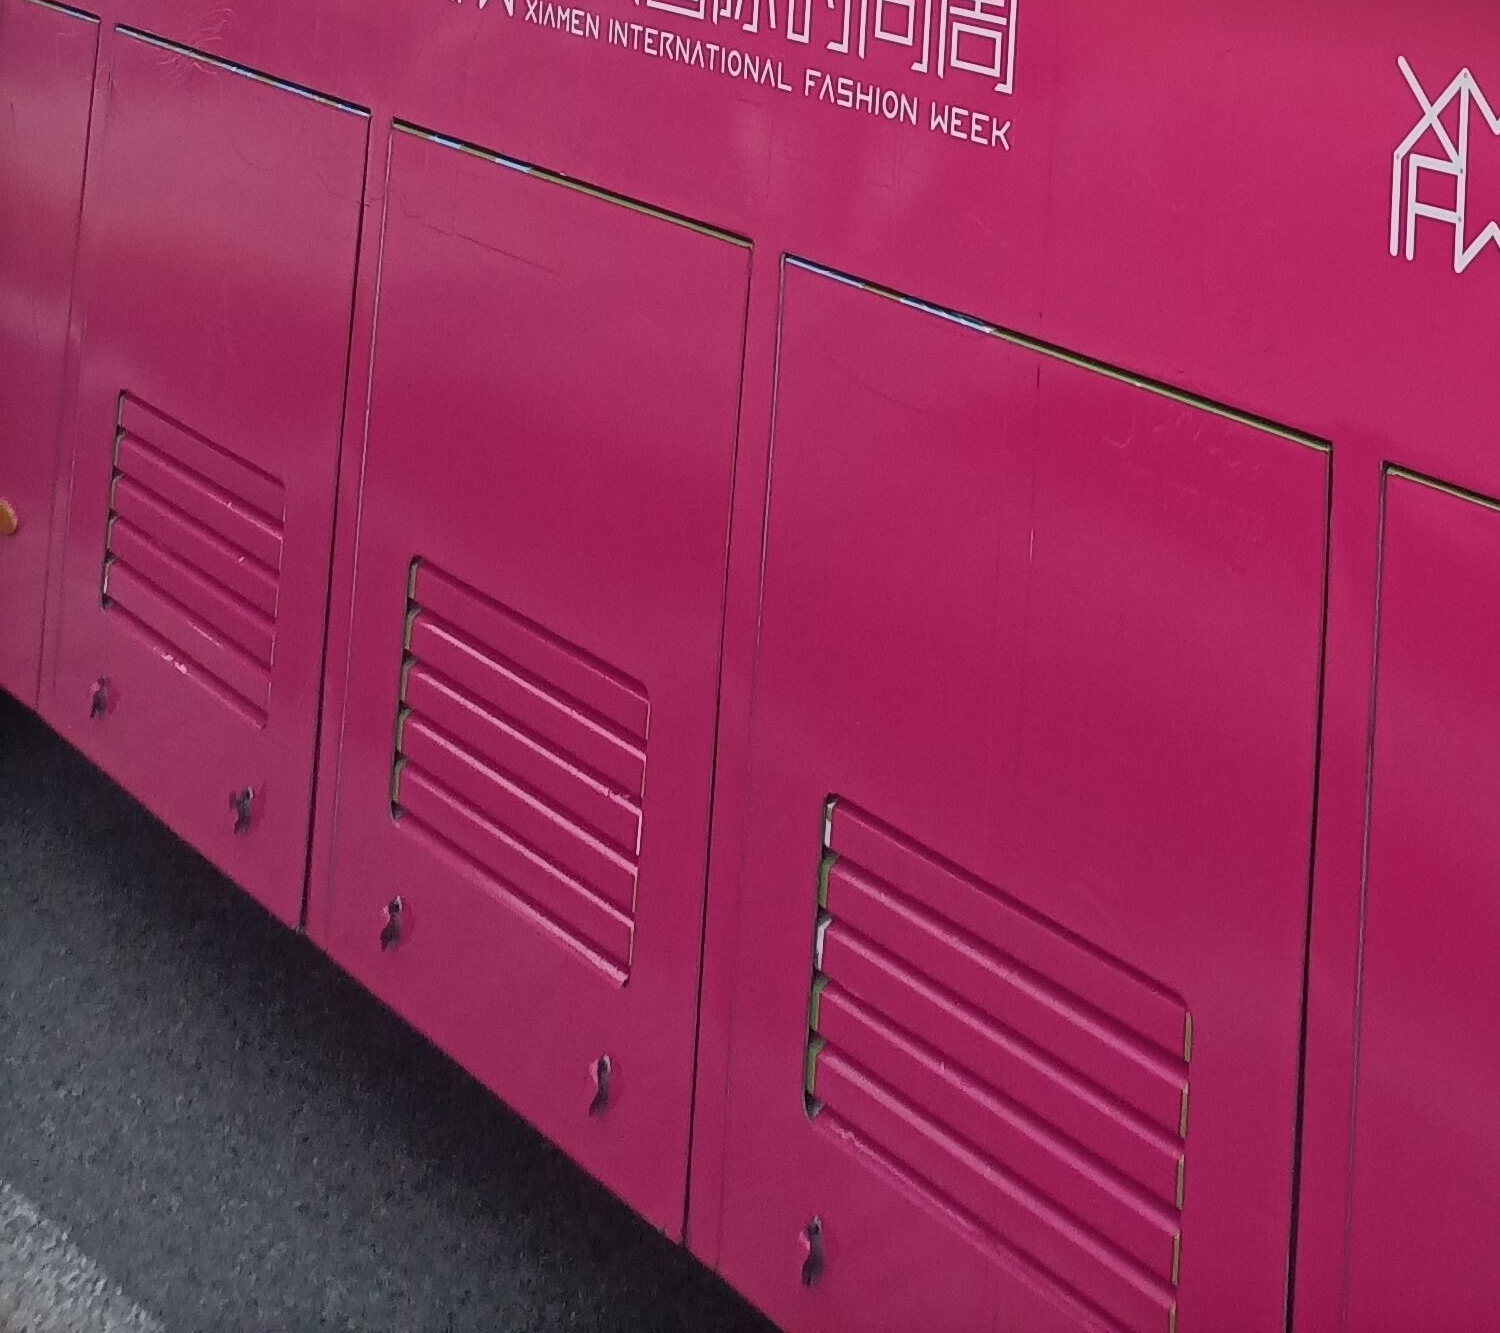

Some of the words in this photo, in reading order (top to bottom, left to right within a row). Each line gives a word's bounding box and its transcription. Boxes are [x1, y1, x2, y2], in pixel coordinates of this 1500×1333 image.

[607, 17, 793, 93] INTERNATIONAL
[803, 68, 919, 127] FASHION
[929, 100, 1012, 152] WEEK
